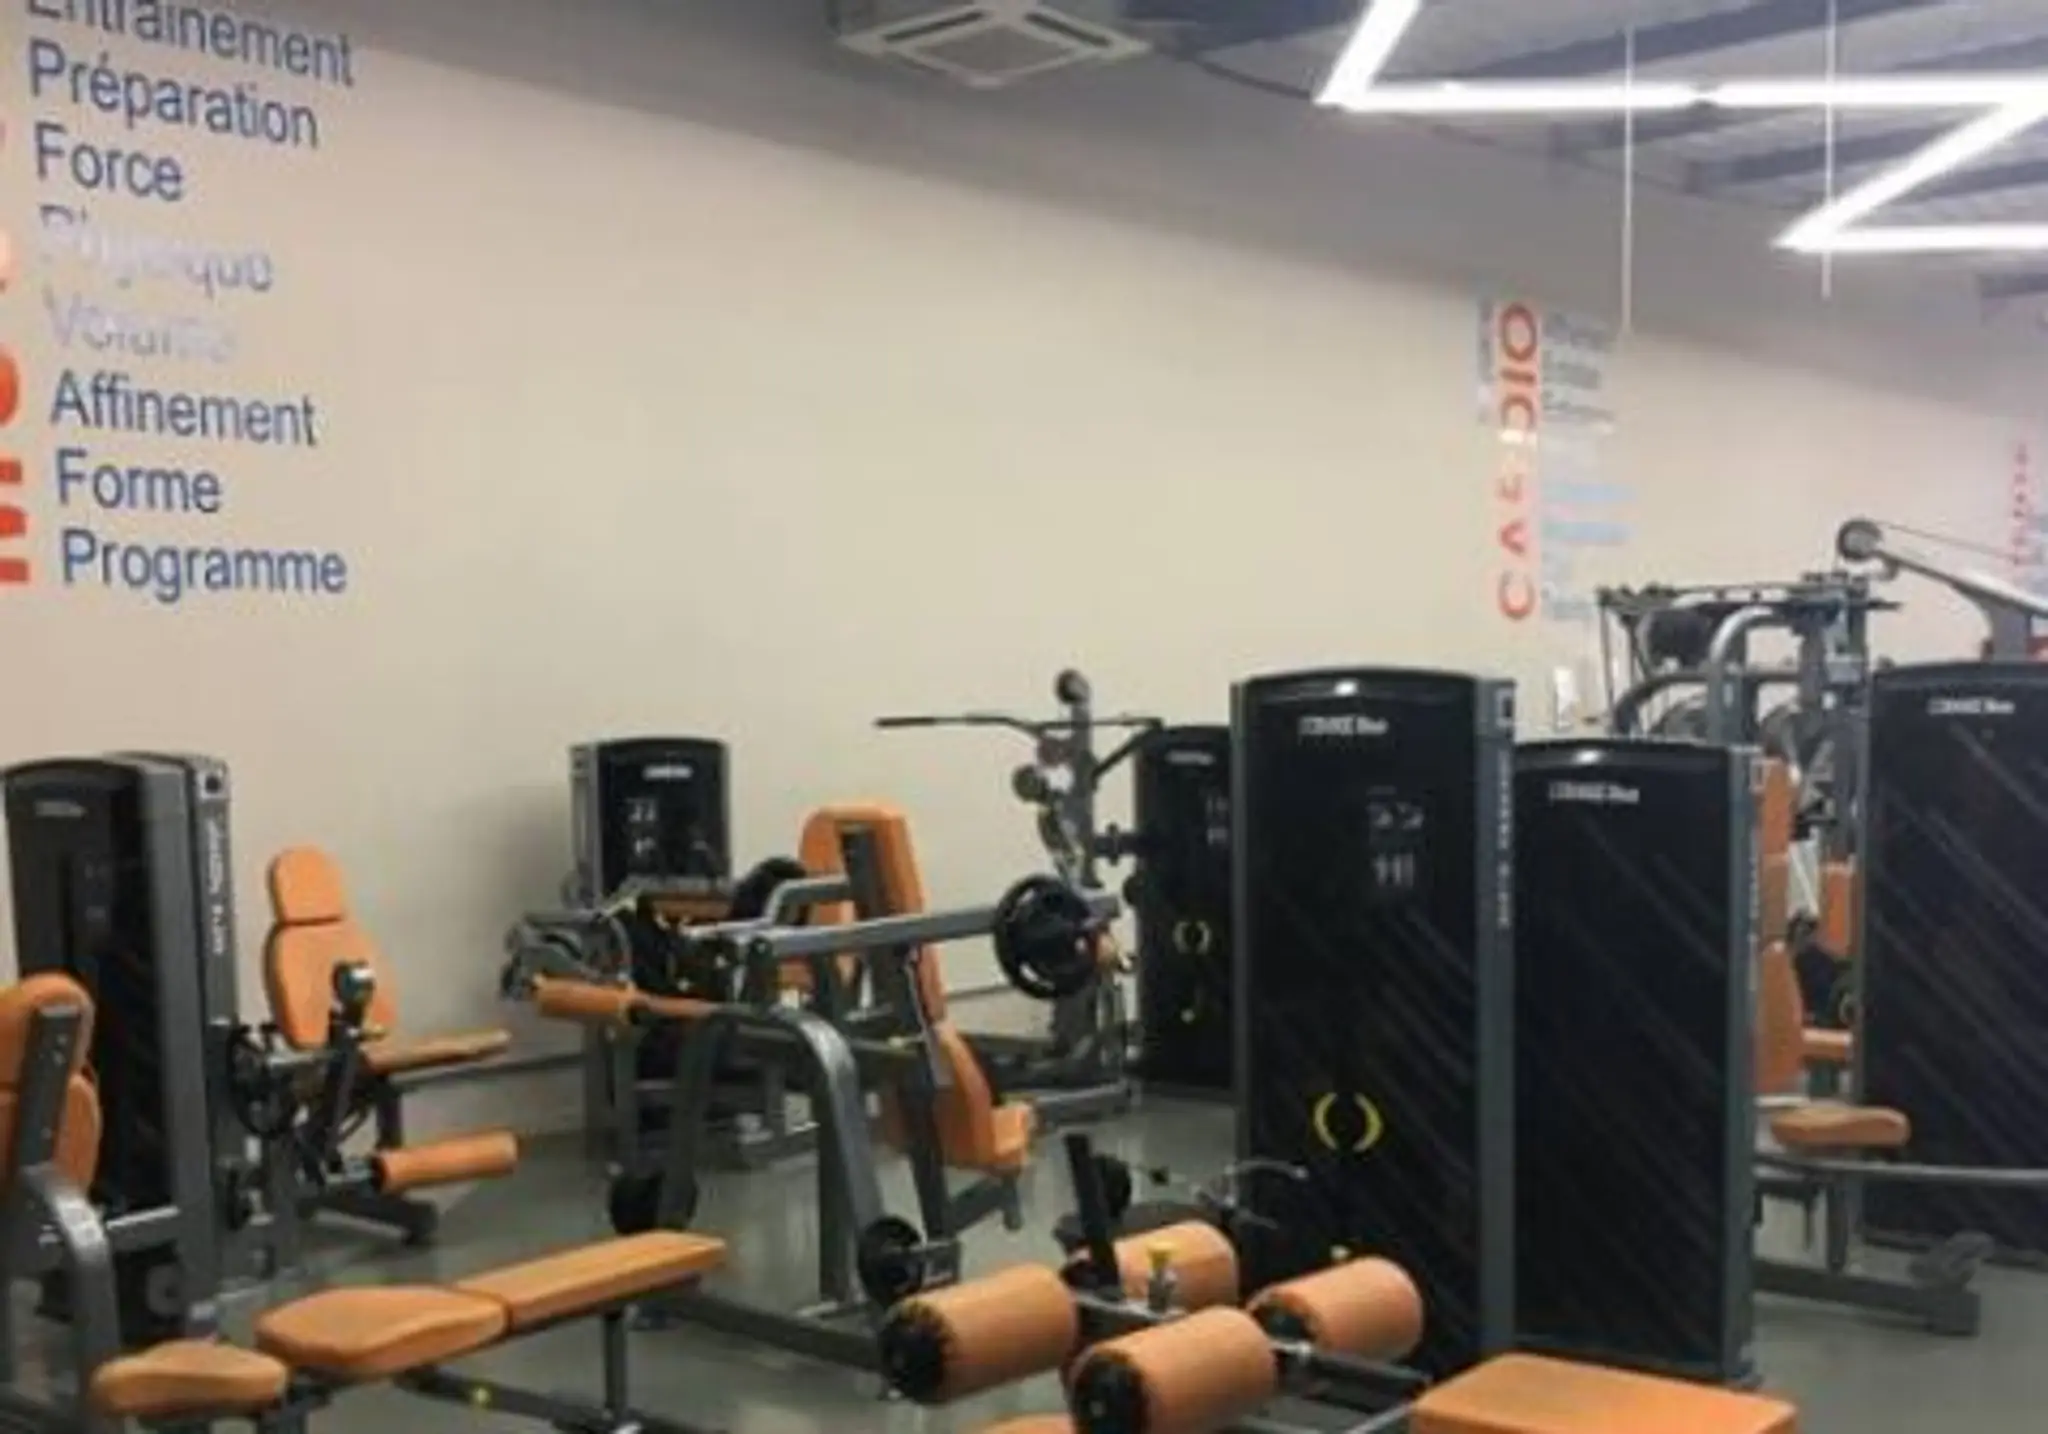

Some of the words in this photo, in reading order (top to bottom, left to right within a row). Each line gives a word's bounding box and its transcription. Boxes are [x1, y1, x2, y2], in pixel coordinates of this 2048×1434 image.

[29, 36, 320, 150] Préparation
[34, 120, 184, 202] Force
[50, 368, 318, 447] Affinement
[55, 447, 223, 514] Forme
[60, 527, 349, 604] Programme
